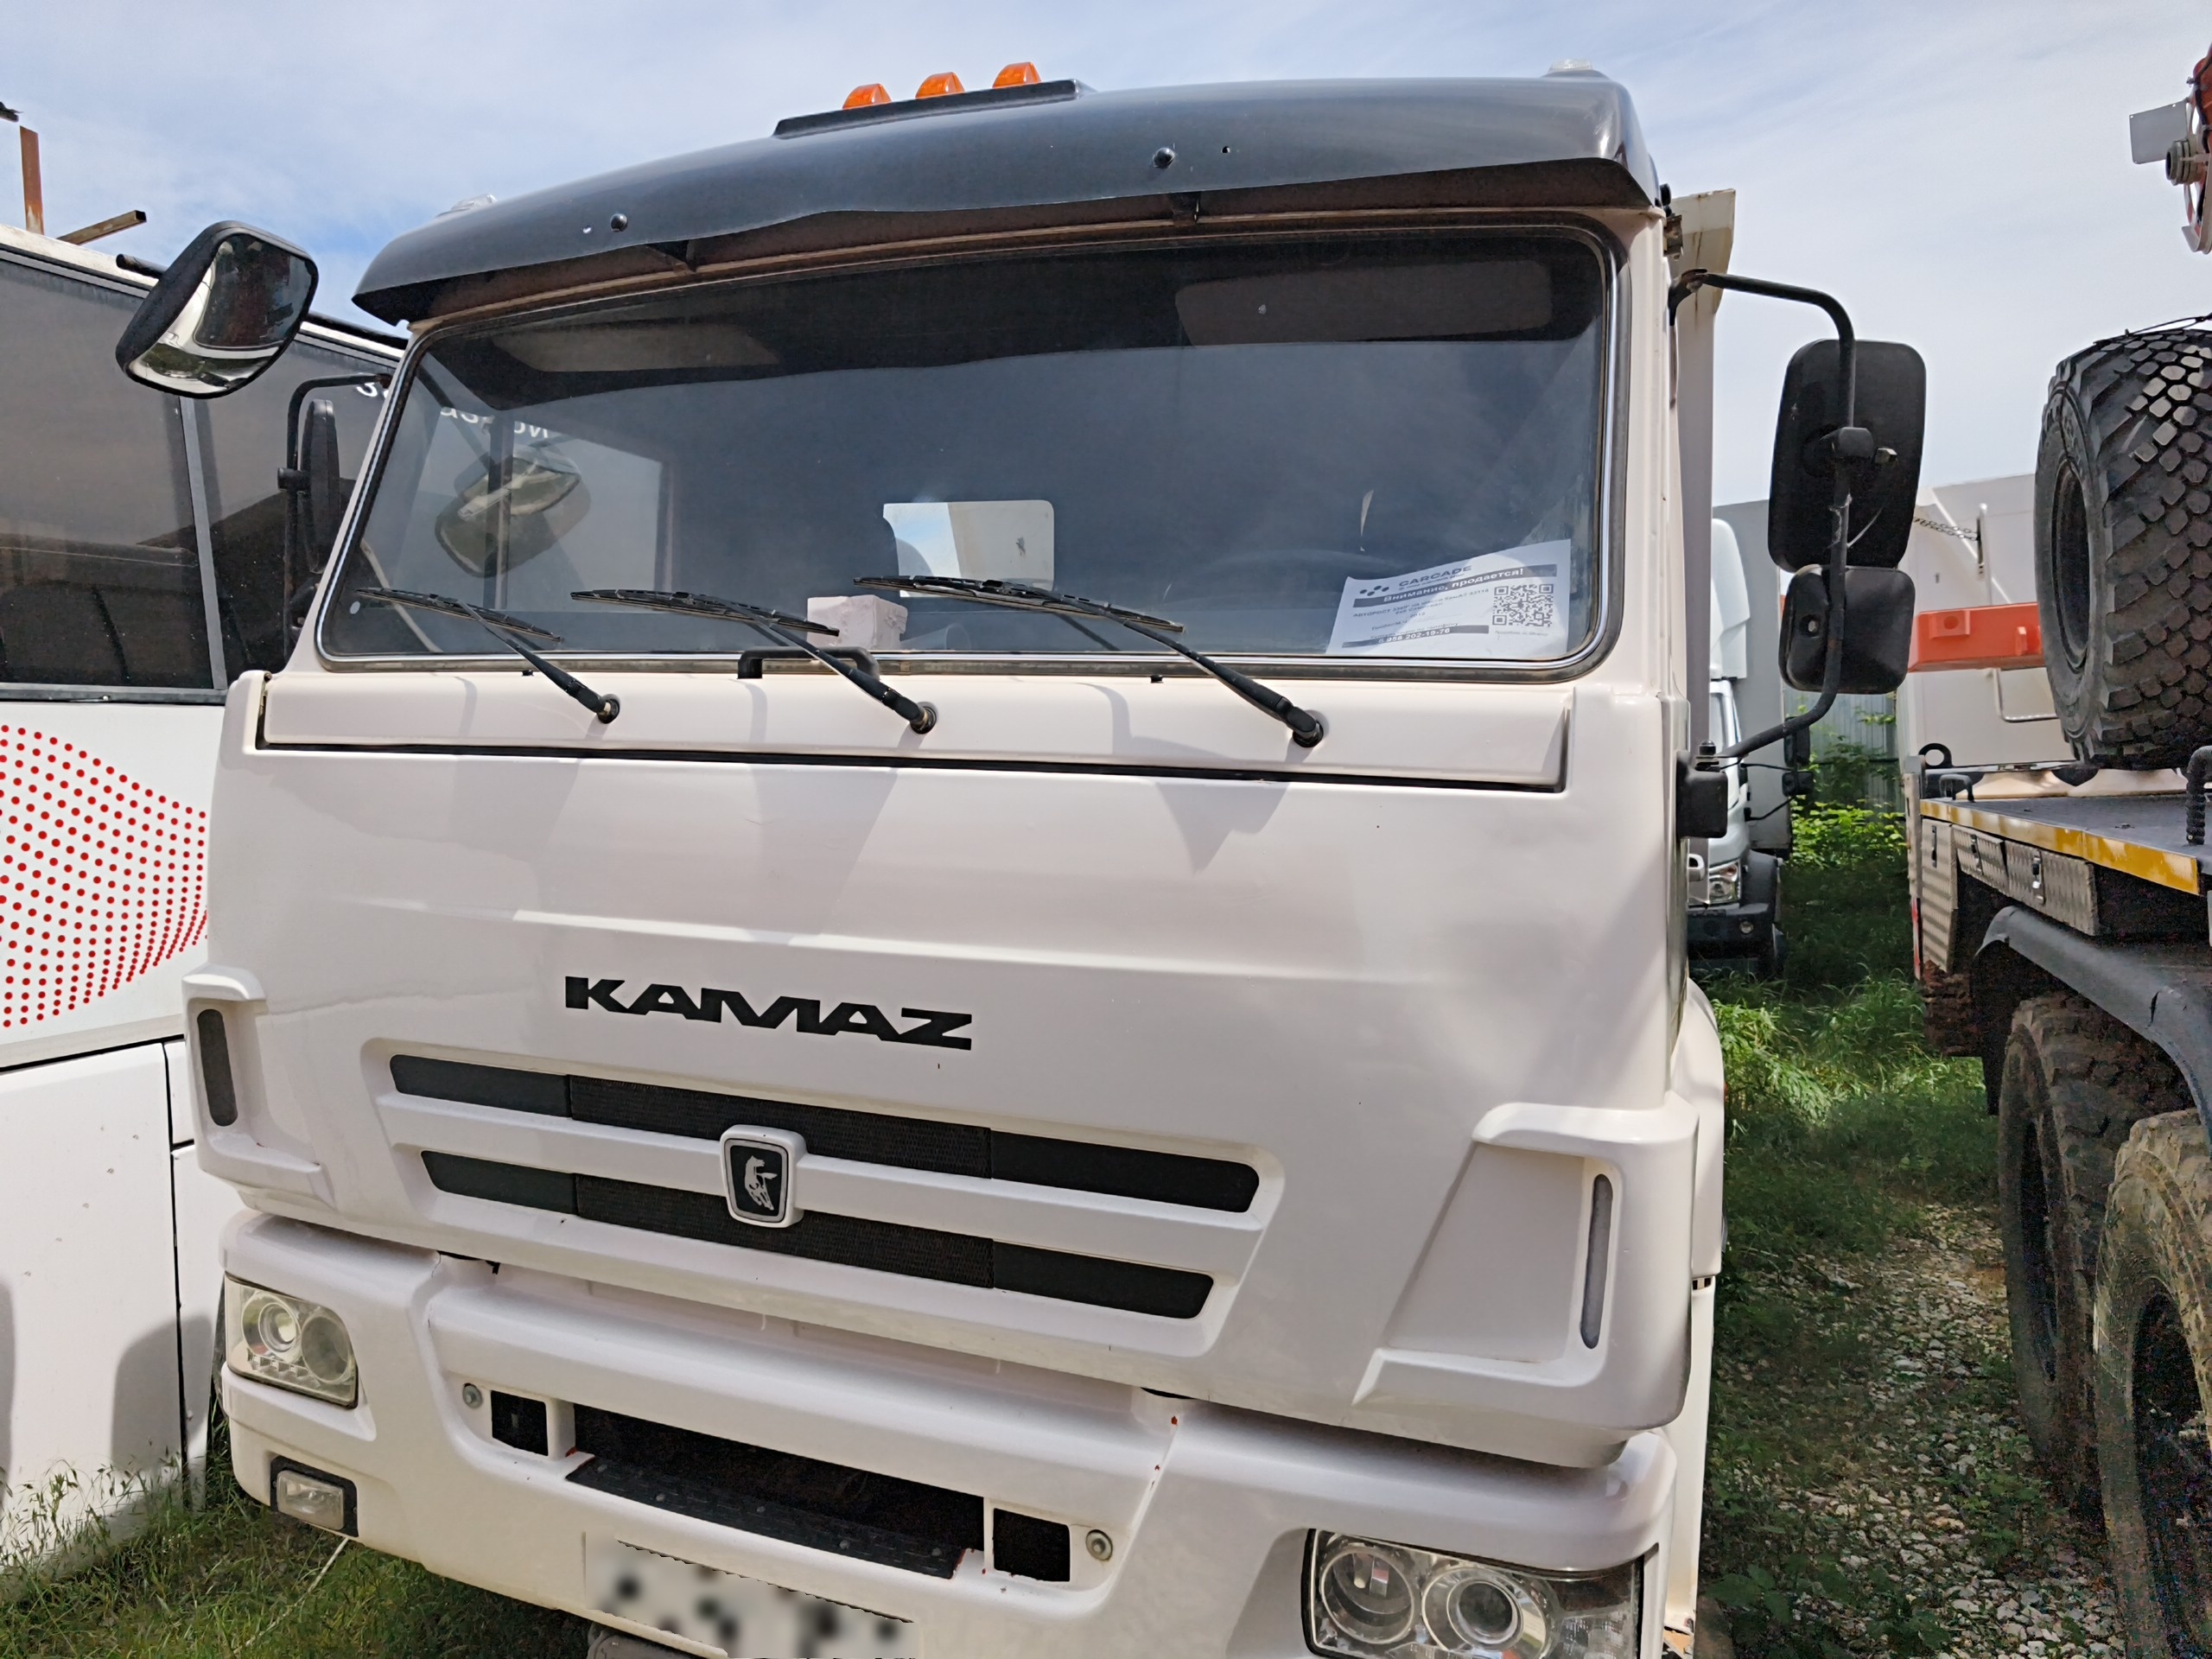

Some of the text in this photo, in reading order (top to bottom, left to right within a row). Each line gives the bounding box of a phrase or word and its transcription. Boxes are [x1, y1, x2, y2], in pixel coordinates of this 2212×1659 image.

[1383, 585, 1448, 602] Внимание,
[1452, 568, 1524, 588] продается!
[1398, 565, 1472, 587] CARCADE
[1405, 627, 1451, 639] 202-19-76
[565, 976, 972, 1051] KAMAZ
